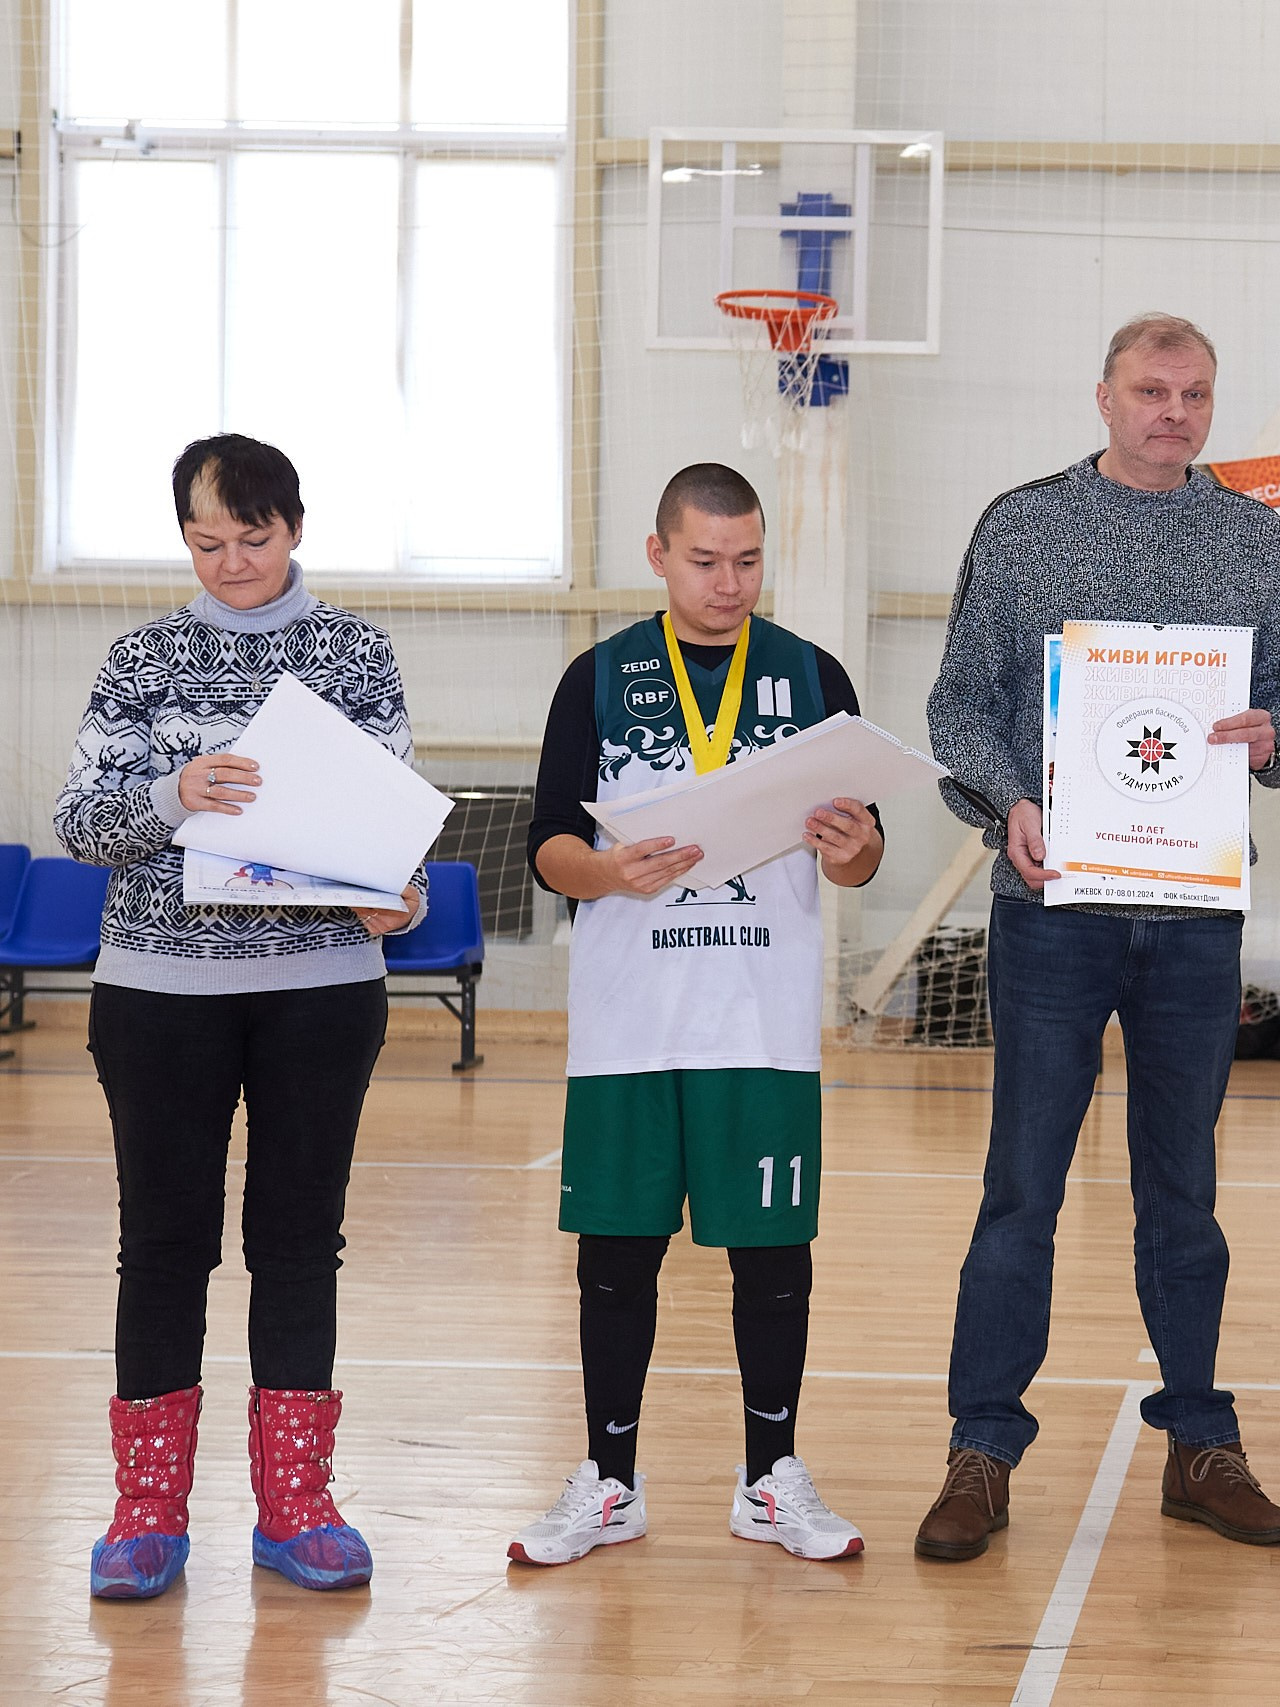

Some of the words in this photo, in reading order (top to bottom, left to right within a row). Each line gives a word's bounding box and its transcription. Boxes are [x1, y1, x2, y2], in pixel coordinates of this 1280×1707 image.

[621, 658, 661, 673] ZEDO
[1086, 648, 1149, 664] ЖИВИ
[1155, 649, 1227, 667] ИГРОЙ!
[1085, 666, 1148, 683] ЖИВИ
[1154, 668, 1227, 687] ИГРОЙ!
[631, 690, 669, 706] RBF
[756, 675, 792, 718] 11
[1084, 684, 1148, 701] ЖИВИ
[1116, 708, 1153, 729] Федерация
[1155, 708, 1190, 733] баскетбола
[1116, 771, 1184, 792] «УДМУРТИЯ»
[1131, 824, 1143, 833] 10
[1147, 825, 1165, 835] ЛЕТ
[1095, 832, 1153, 846] УСПЕШНОЙ
[1156, 837, 1199, 849] РАБОТЫ
[1074, 887, 1102, 896] ИЖЕВСК
[1105, 888, 1154, 899] 07-08.01.2024
[1163, 892, 1178, 900] ФОК
[652, 926, 737, 950] BASKETBALL
[740, 926, 770, 947] CLUB
[758, 1155, 802, 1208] 11
